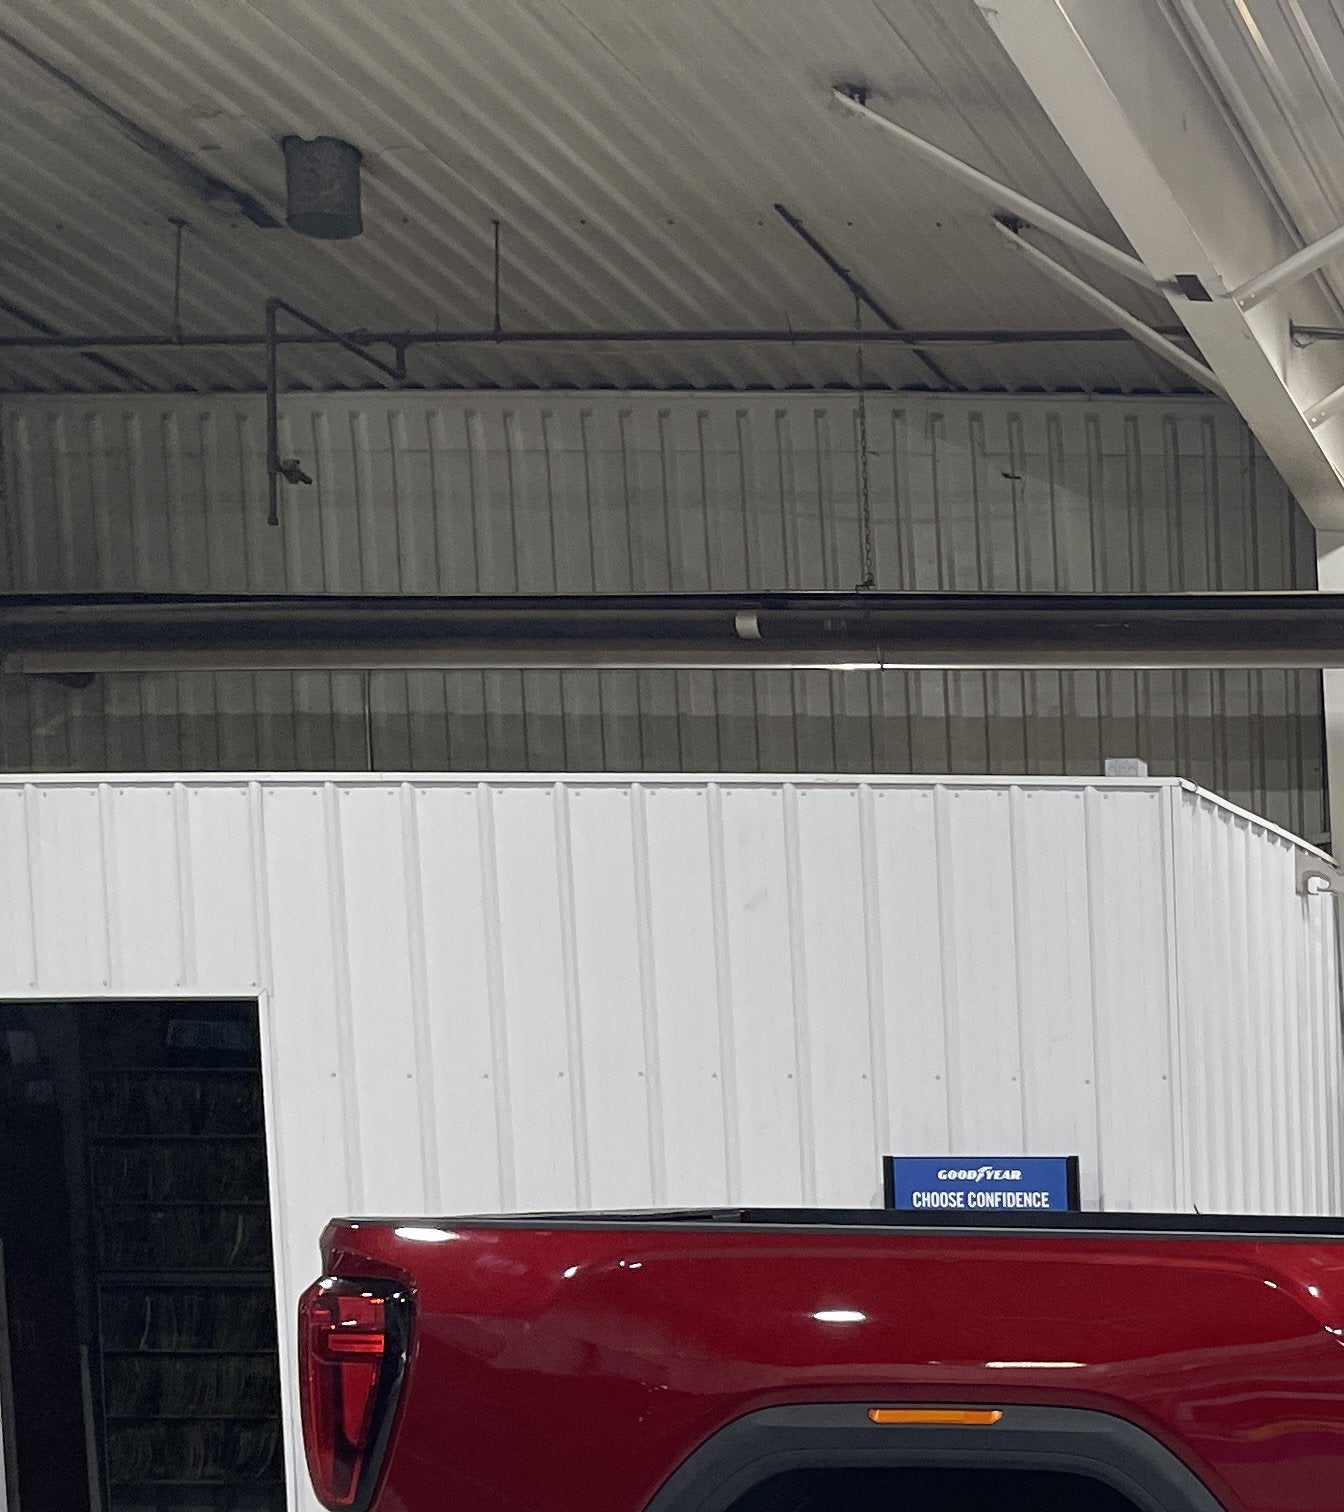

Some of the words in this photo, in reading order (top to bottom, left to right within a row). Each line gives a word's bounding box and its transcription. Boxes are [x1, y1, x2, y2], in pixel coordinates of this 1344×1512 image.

[937, 1167, 1022, 1181] GOODYEAR
[912, 1191, 965, 1208] CHOOSE
[967, 1191, 1050, 1208] CONFIDENCE
